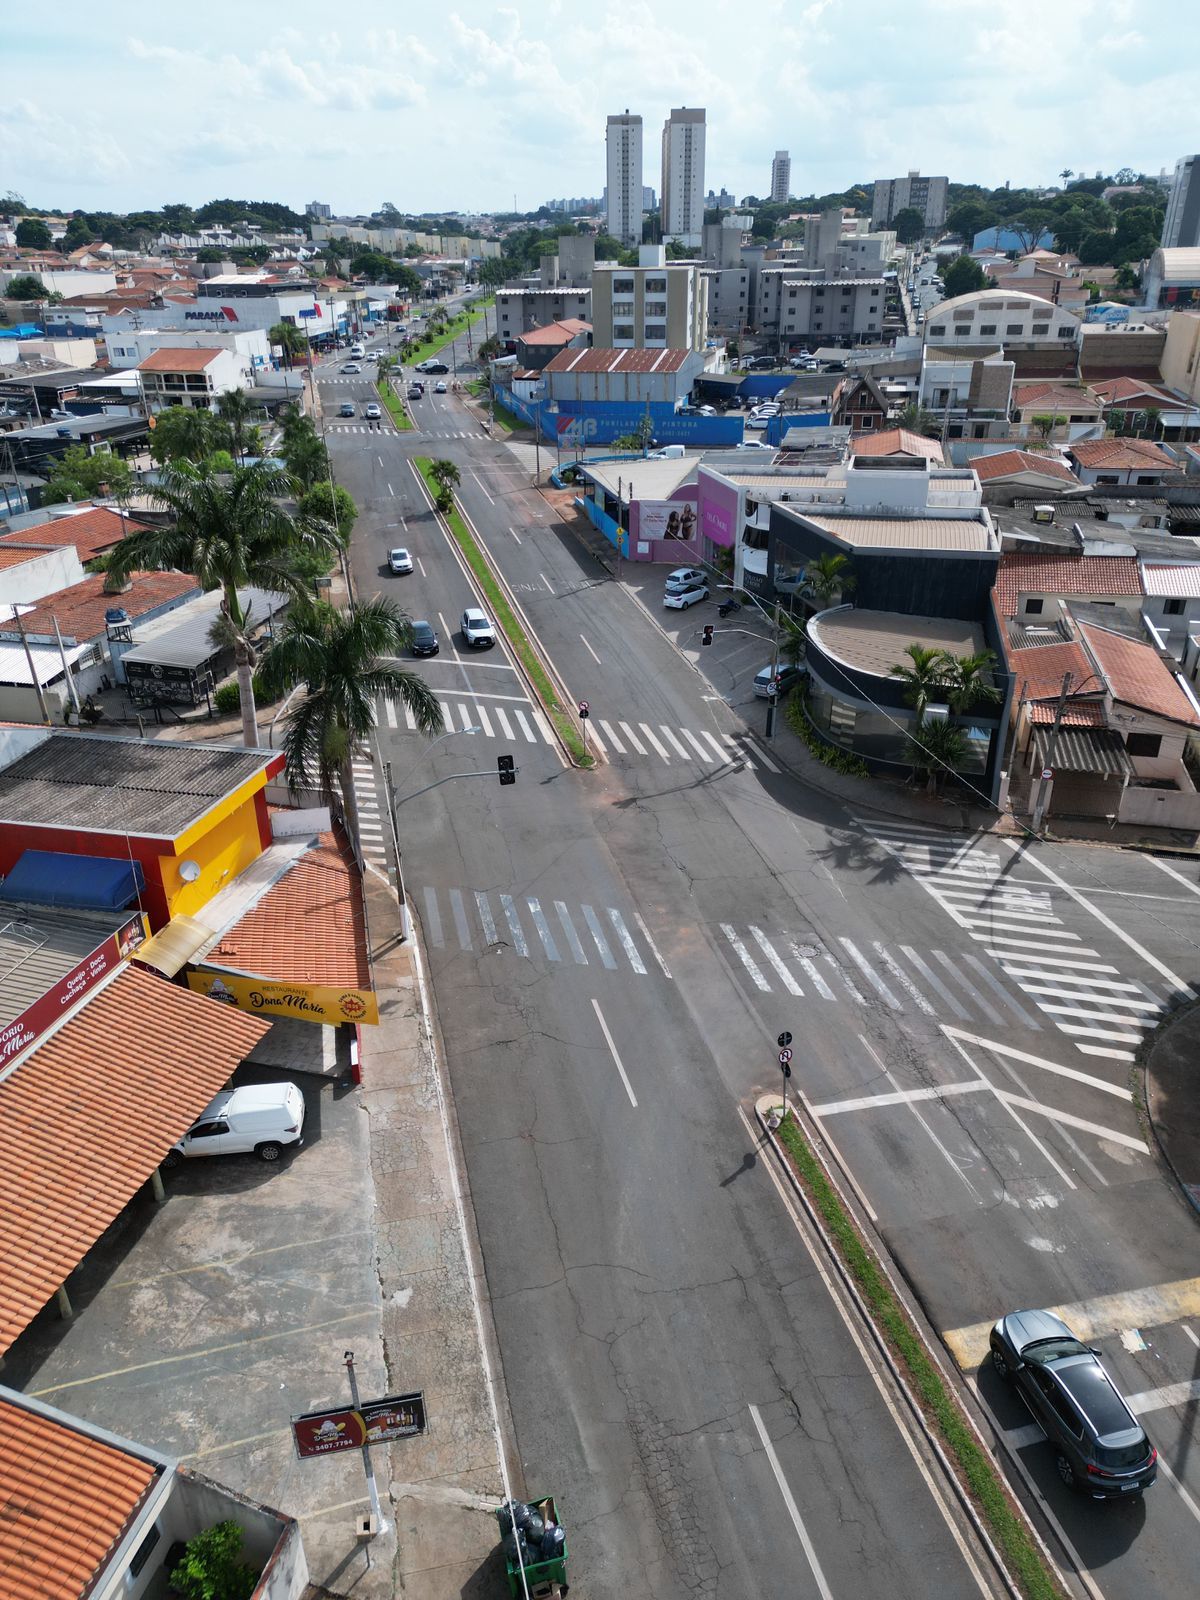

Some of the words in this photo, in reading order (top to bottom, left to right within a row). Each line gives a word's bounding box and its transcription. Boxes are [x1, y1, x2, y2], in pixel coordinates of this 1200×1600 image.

[60, 980, 86, 1004] Cachaça
[90, 961, 107, 977] Vinho
[66, 970, 85, 988] Queijo
[89, 954, 104, 968] Doce
[249, 991, 283, 1007] Dona
[282, 994, 326, 1014] Maria
[262, 985, 309, 996] RESTAURANTE
